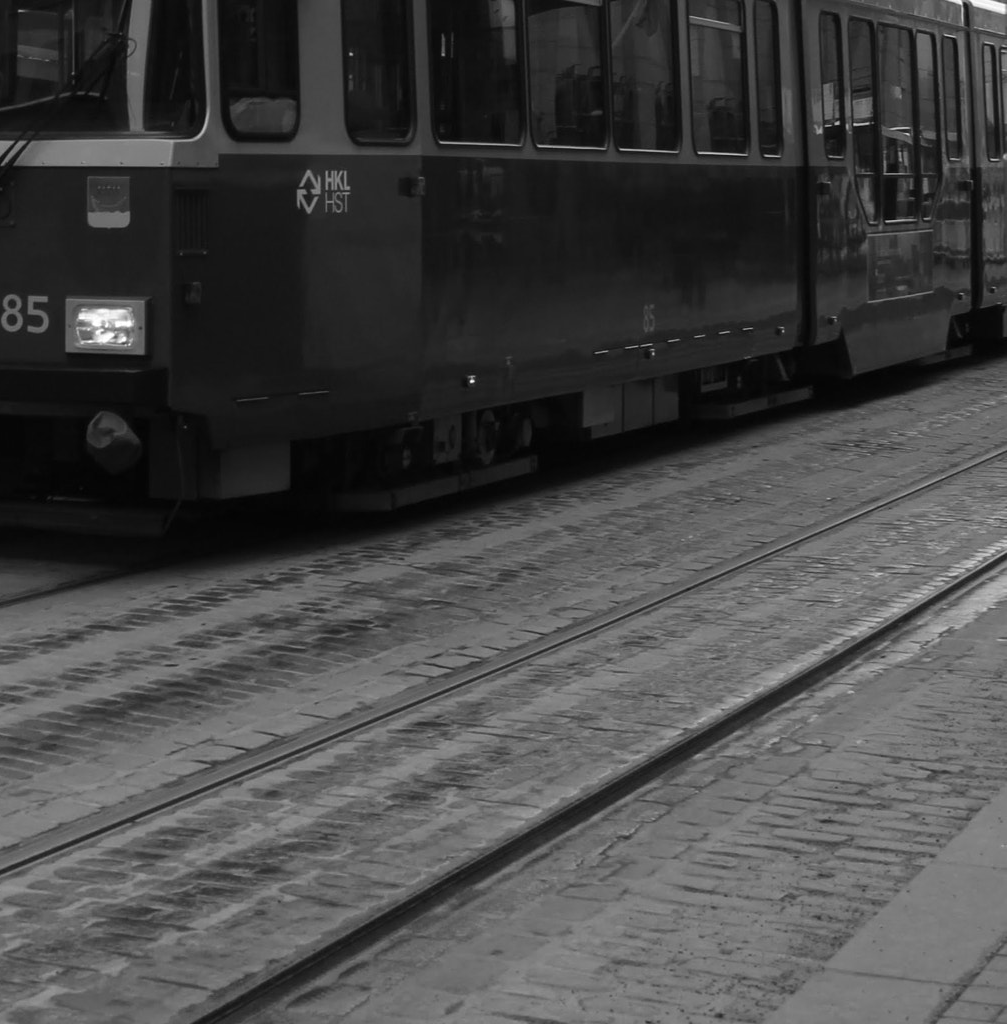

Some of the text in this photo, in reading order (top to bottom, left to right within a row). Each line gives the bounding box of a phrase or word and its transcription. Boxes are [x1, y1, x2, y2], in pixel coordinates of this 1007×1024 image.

[325, 170, 351, 191] HKL
[325, 192, 351, 213] HST
[0, 294, 50, 334] 85
